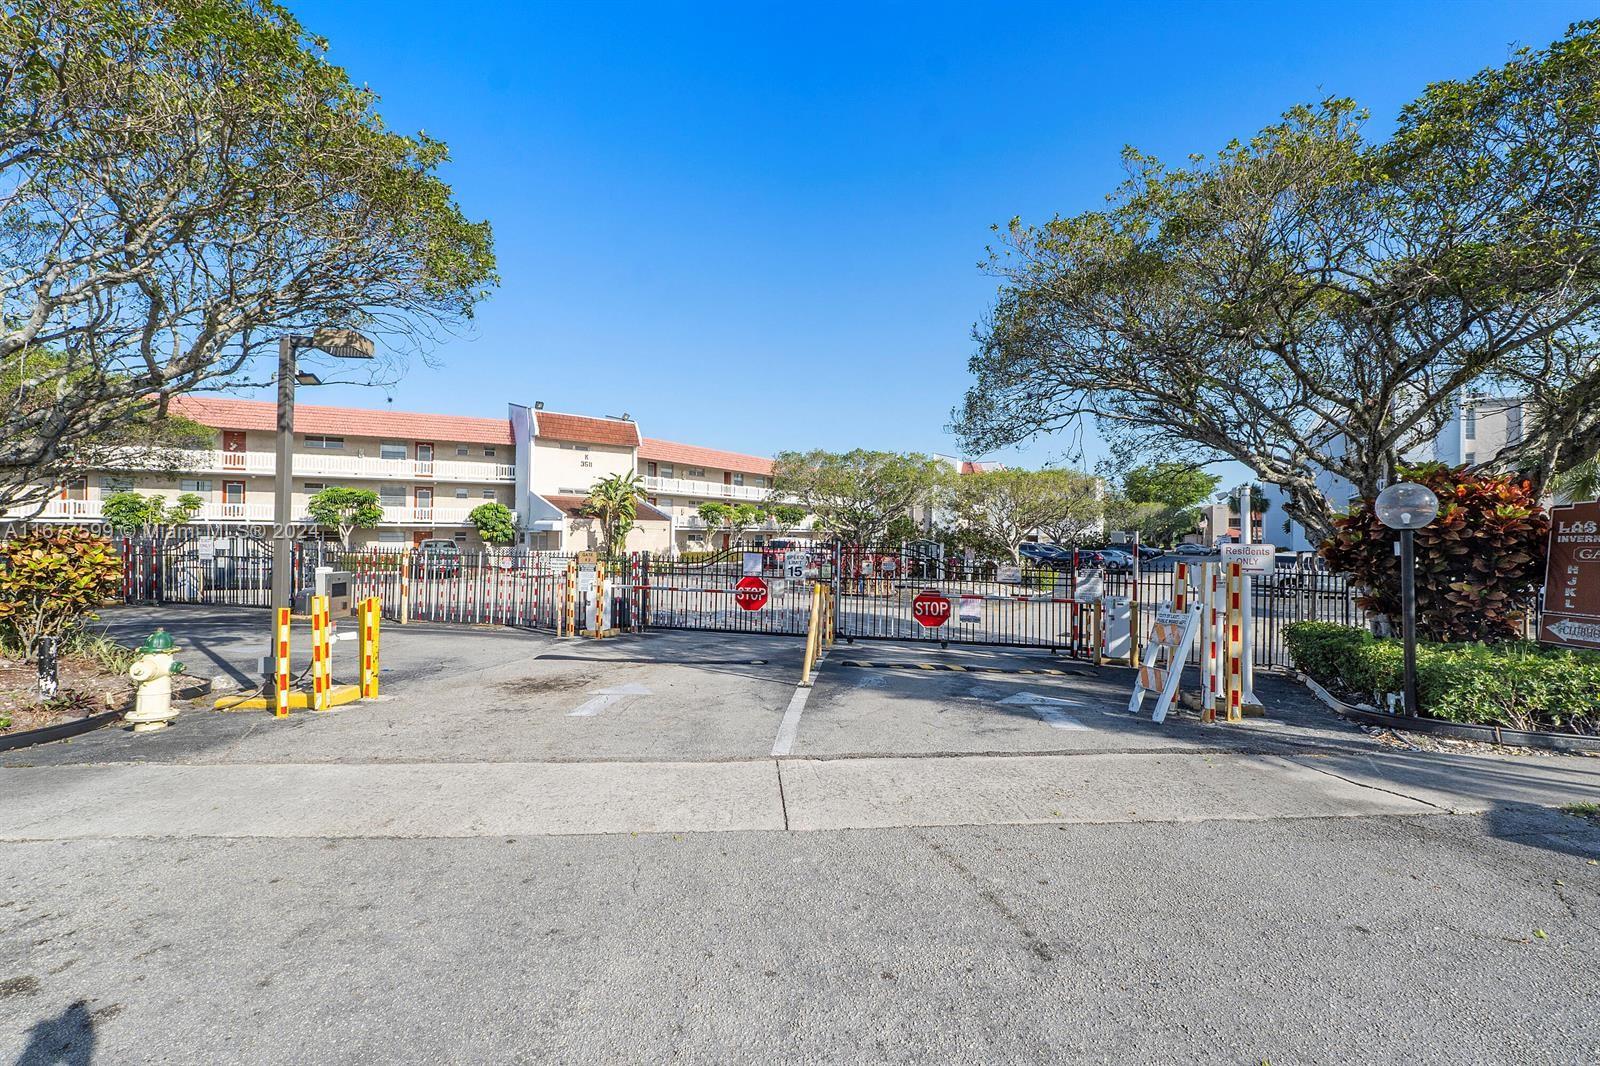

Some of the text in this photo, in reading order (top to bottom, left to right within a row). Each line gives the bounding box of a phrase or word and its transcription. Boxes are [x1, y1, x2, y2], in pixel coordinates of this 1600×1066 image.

[1558, 521, 1598, 534] LAS
[1226, 547, 1270, 556] Residents
[1236, 558, 1258, 566] ONLY
[788, 566, 802, 577] 15
[1567, 564, 1578, 574] H
[1567, 577, 1577, 586] J
[736, 587, 766, 600] STOP
[1564, 588, 1576, 597] K
[1564, 599, 1574, 608] L
[915, 602, 948, 616] STOP
